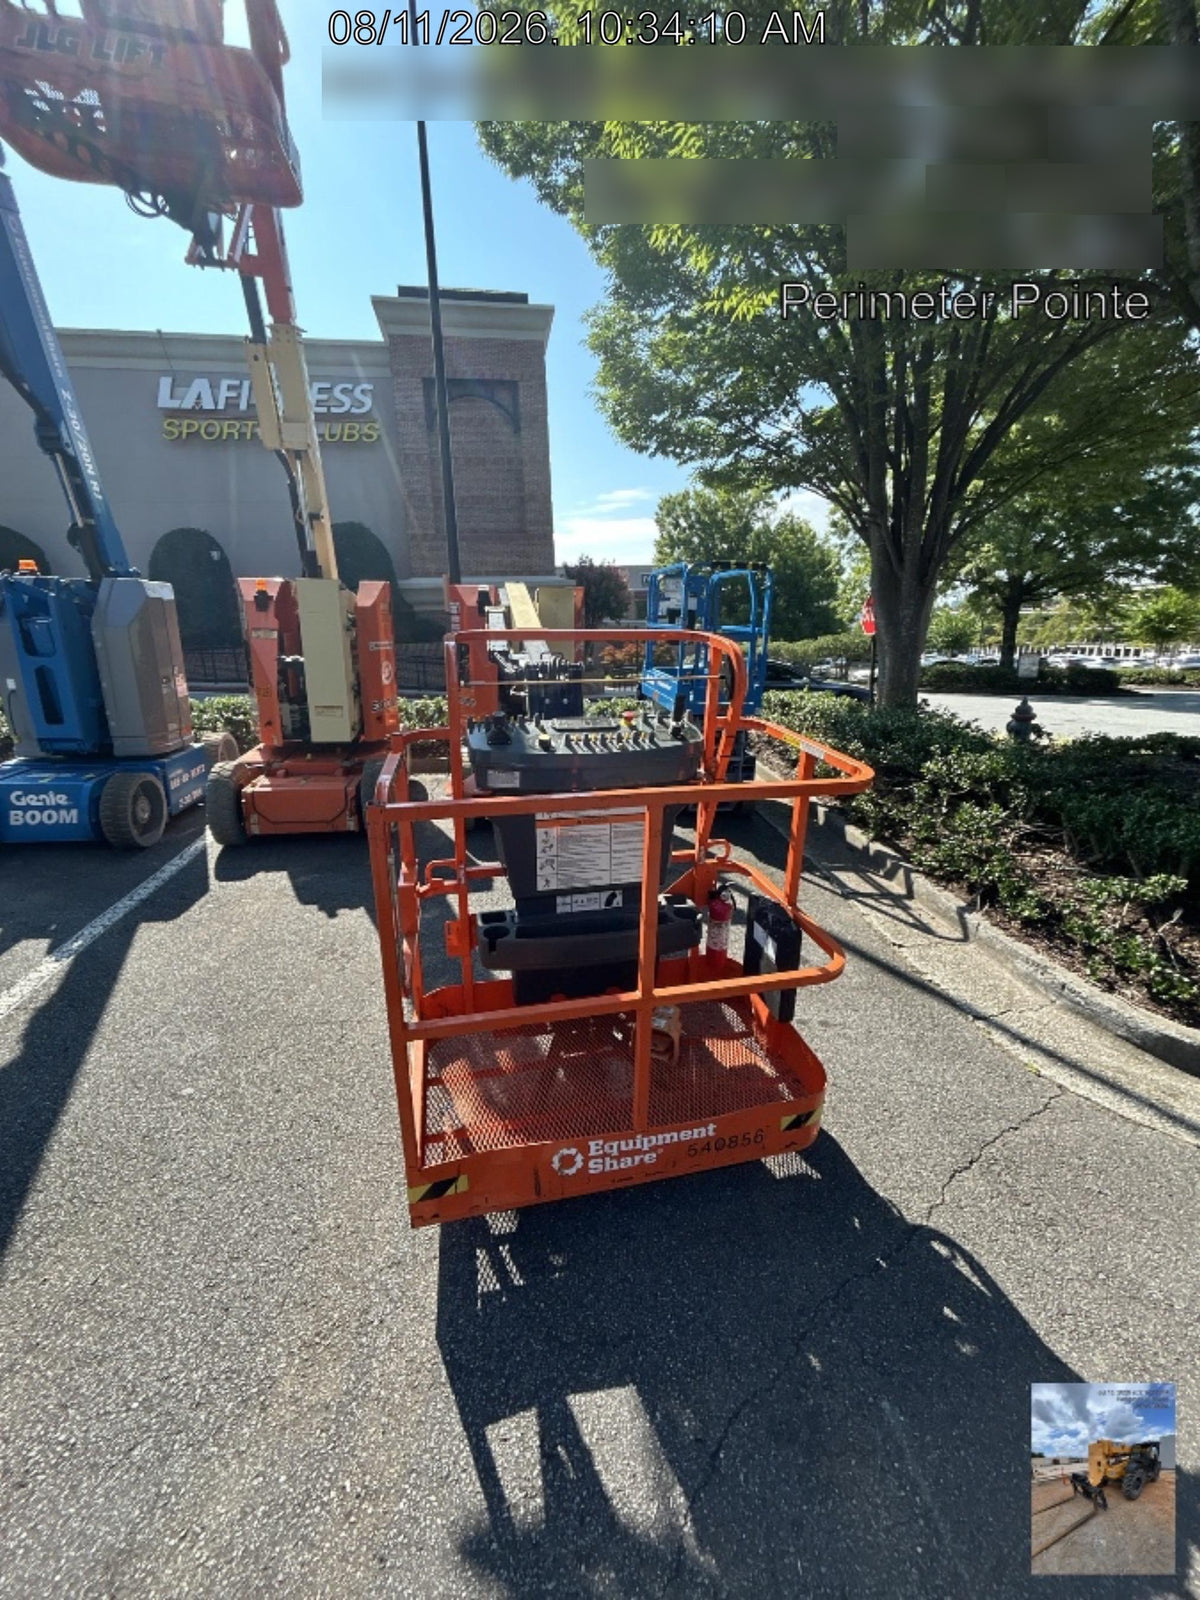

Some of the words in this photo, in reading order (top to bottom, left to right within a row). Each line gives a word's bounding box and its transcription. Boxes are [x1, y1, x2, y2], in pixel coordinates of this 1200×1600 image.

[15, 22, 81, 56] JLG
[91, 34, 164, 66] LIFT
[162, 418, 262, 441] SPORT
[9, 790, 69, 806] Genie
[9, 808, 79, 826] BOOM
[587, 1122, 717, 1157] Equipment
[687, 1128, 765, 1157] 540856
[587, 1151, 658, 1176] Share
